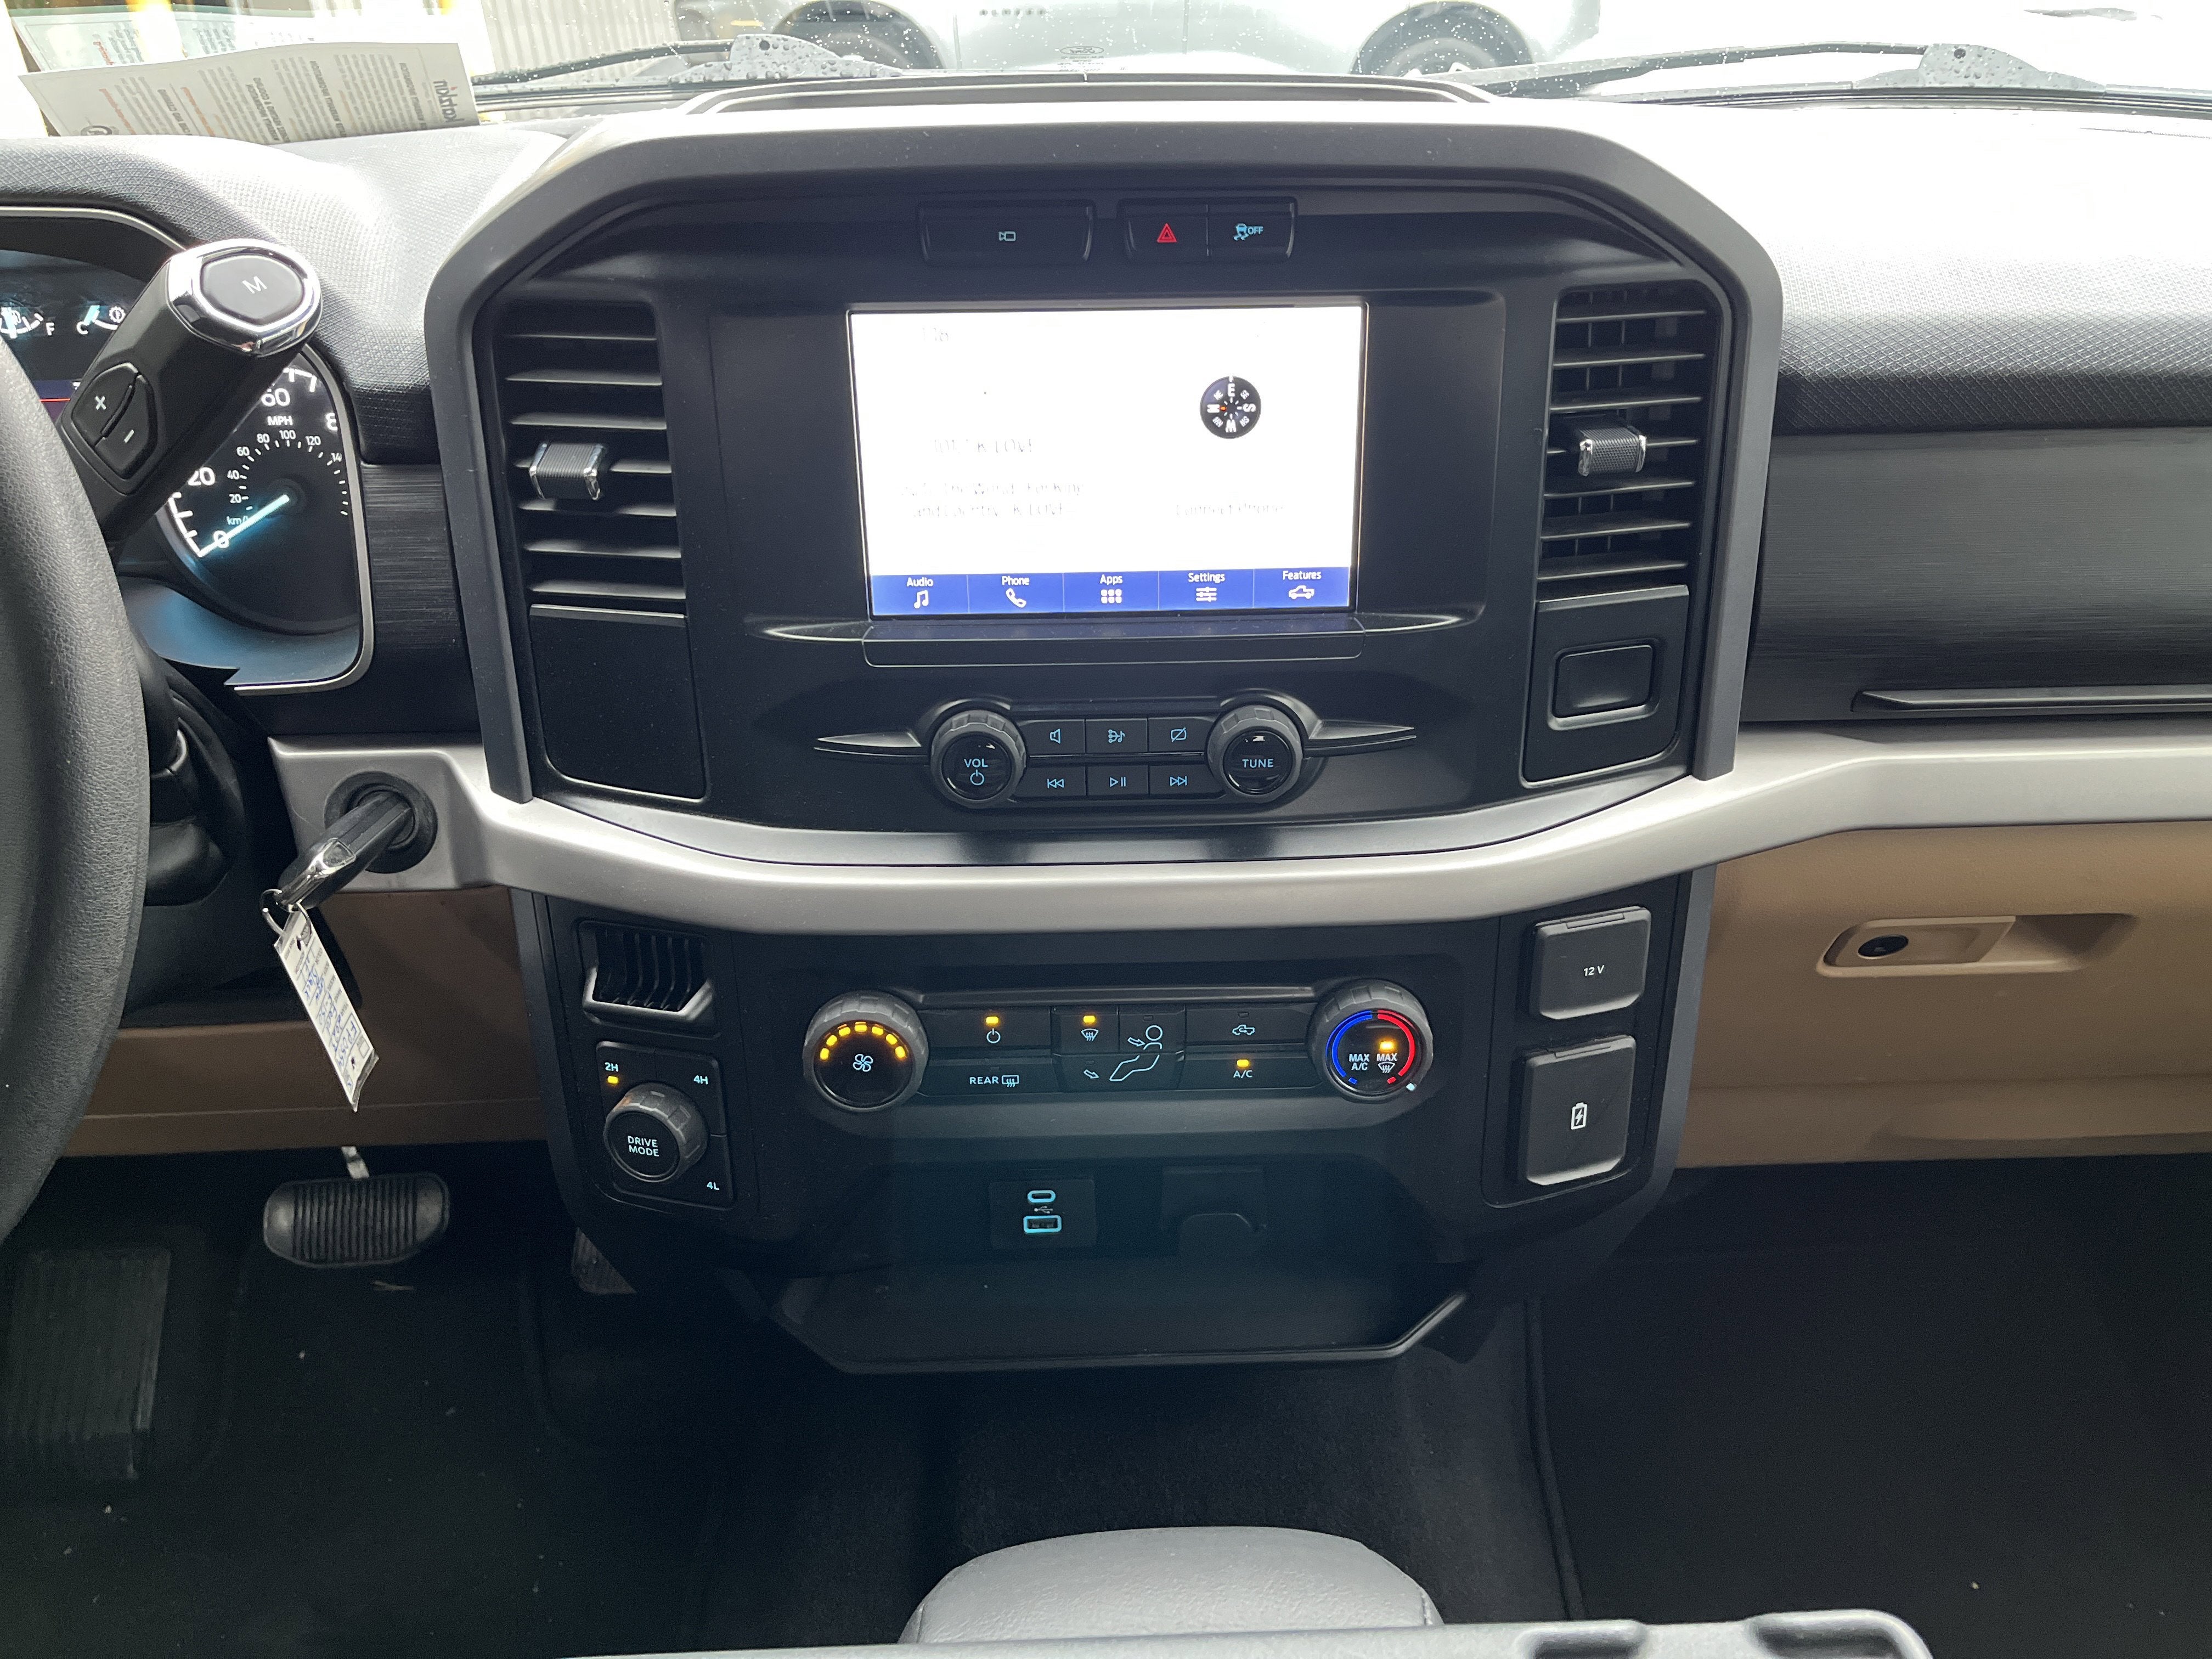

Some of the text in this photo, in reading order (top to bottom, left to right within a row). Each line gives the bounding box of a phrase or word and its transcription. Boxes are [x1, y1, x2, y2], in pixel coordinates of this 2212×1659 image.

[1248, 226, 1263, 235] OFF
[242, 276, 267, 294] M
[46, 322, 55, 336] F
[76, 321, 88, 335] C
[1228, 383, 1235, 397] E
[261, 387, 291, 407] 60
[1243, 403, 1256, 412] S
[267, 415, 293, 426] MPH
[257, 433, 270, 443] 80
[279, 430, 296, 440] 100
[305, 436, 321, 446] 120
[236, 447, 250, 456] 60
[187, 467, 216, 486] 20
[227, 470, 240, 480] 40
[229, 493, 241, 504] 20
[1001, 575, 1030, 586] Phone
[1100, 574, 1123, 587] Apps
[1188, 571, 1224, 585] Settings
[1282, 569, 1322, 582] Features
[906, 577, 933, 588] Audio
[964, 758, 988, 768] VOL
[1242, 759, 1274, 768] TUNE
[1583, 964, 1605, 977] 12 V
[1348, 1053, 1370, 1063] MAX
[1376, 1053, 1397, 1063] MAX
[605, 1062, 619, 1072] 2H
[1351, 1062, 1369, 1071] A/C
[1233, 1070, 1253, 1079] A/C
[693, 1075, 708, 1085] 4H
[969, 1076, 999, 1085] REAR
[627, 1135, 658, 1148] DRIVE
[629, 1146, 659, 1157] MODE
[707, 1181, 720, 1190] 4L
